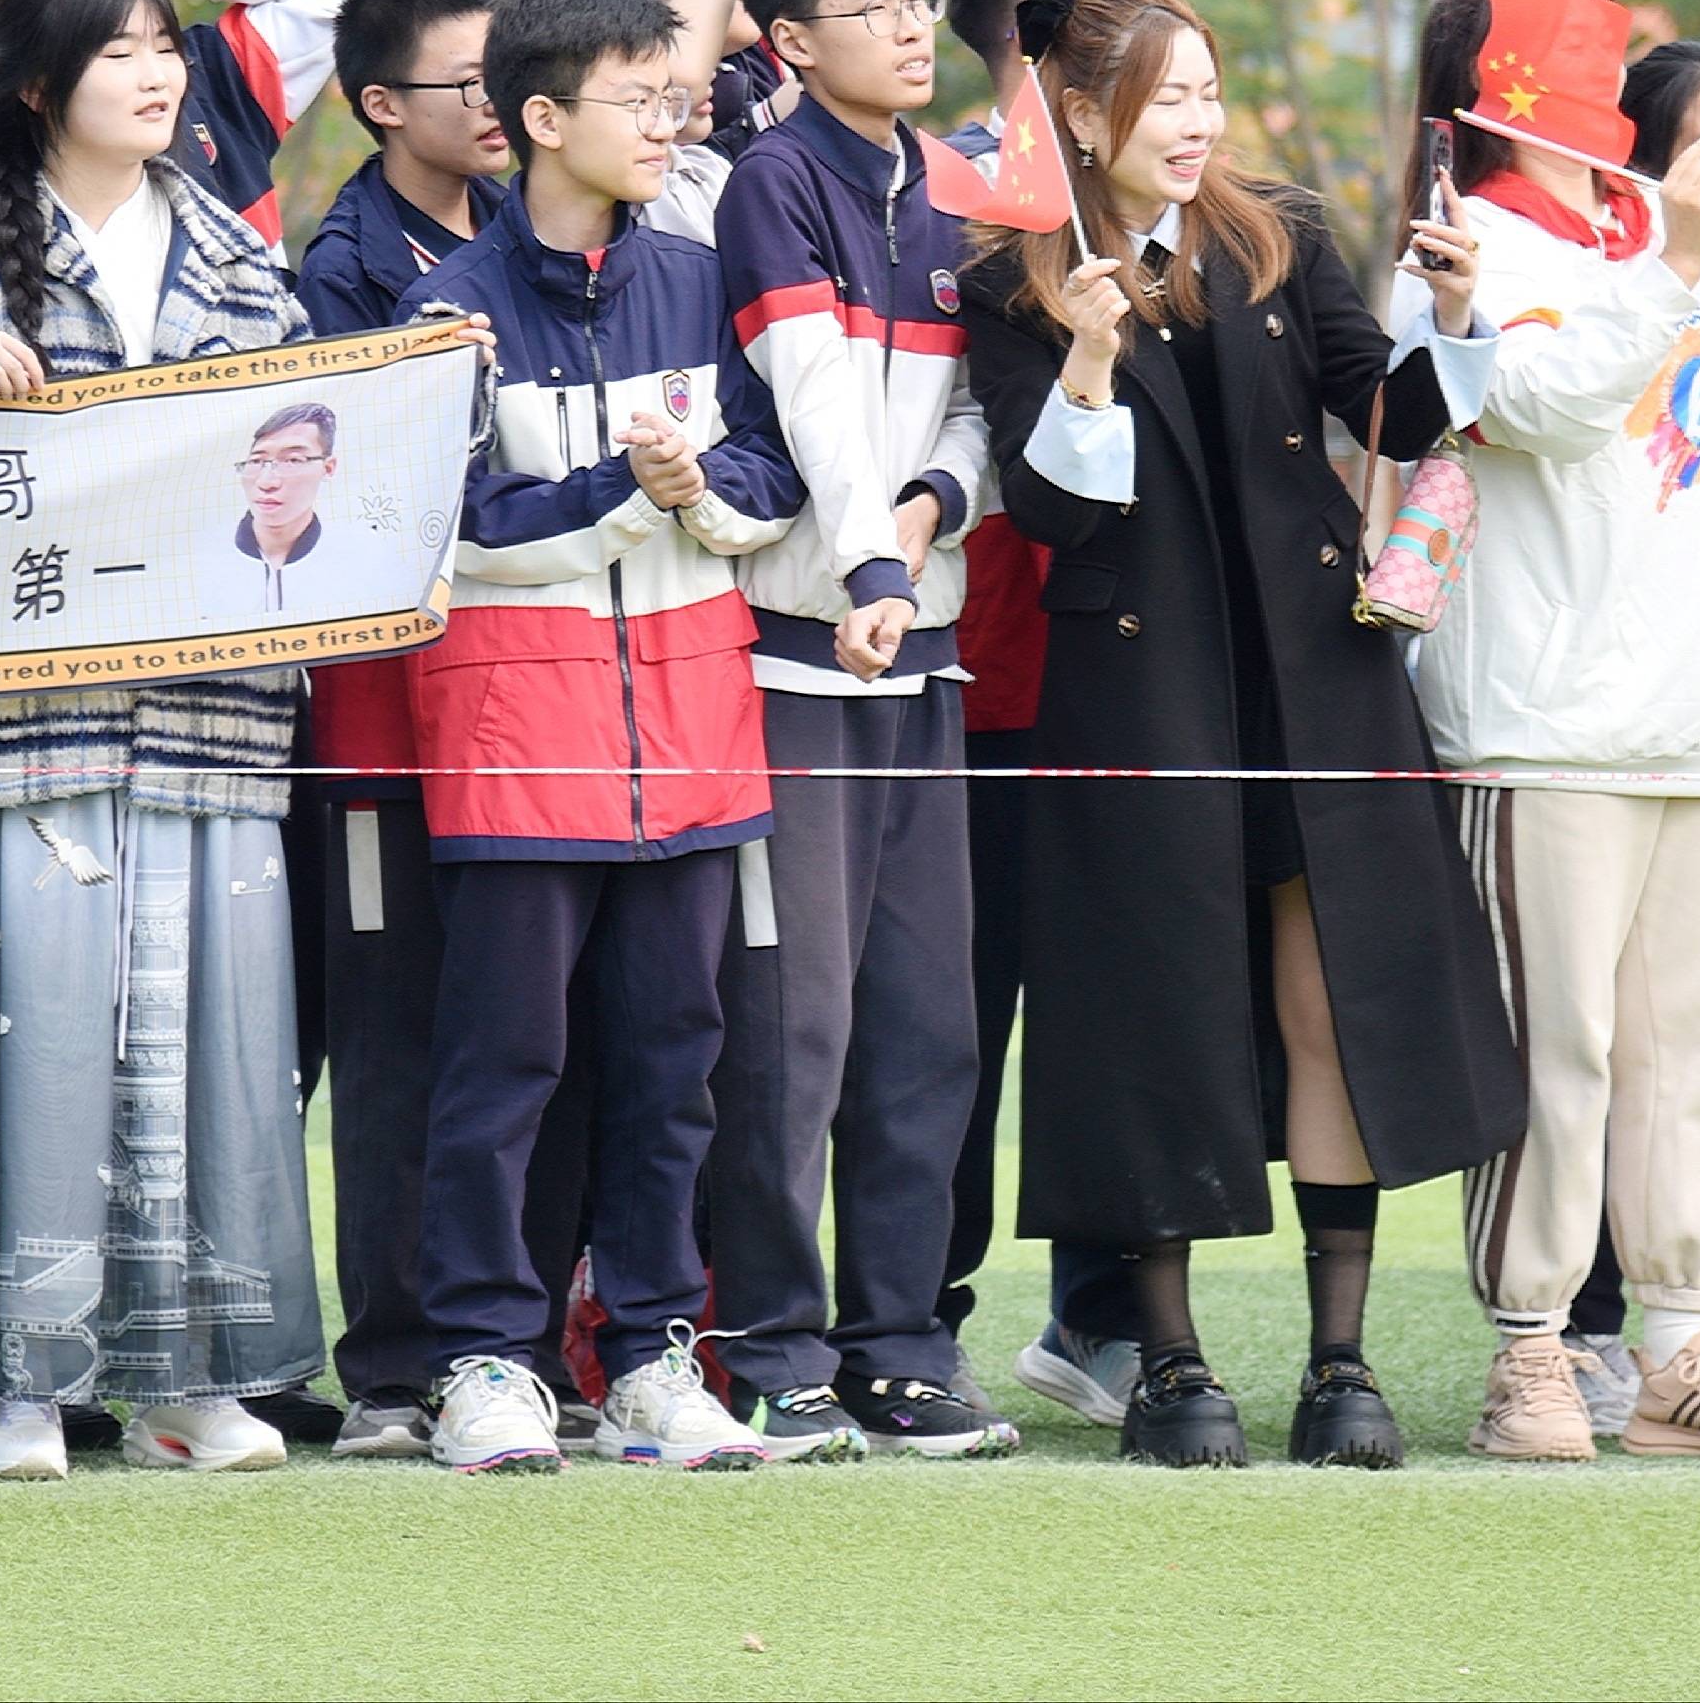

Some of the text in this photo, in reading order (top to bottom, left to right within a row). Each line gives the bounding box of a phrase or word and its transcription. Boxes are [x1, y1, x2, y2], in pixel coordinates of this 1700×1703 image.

[73, 381, 126, 404] you
[136, 376, 165, 389] to
[174, 364, 240, 384] take
[250, 358, 298, 376] the
[306, 346, 373, 369] first
[65, 656, 124, 682] you
[133, 651, 166, 670] to
[174, 643, 247, 664] take
[256, 635, 308, 655] the
[316, 625, 385, 648] first
[393, 617, 439, 642] pla
